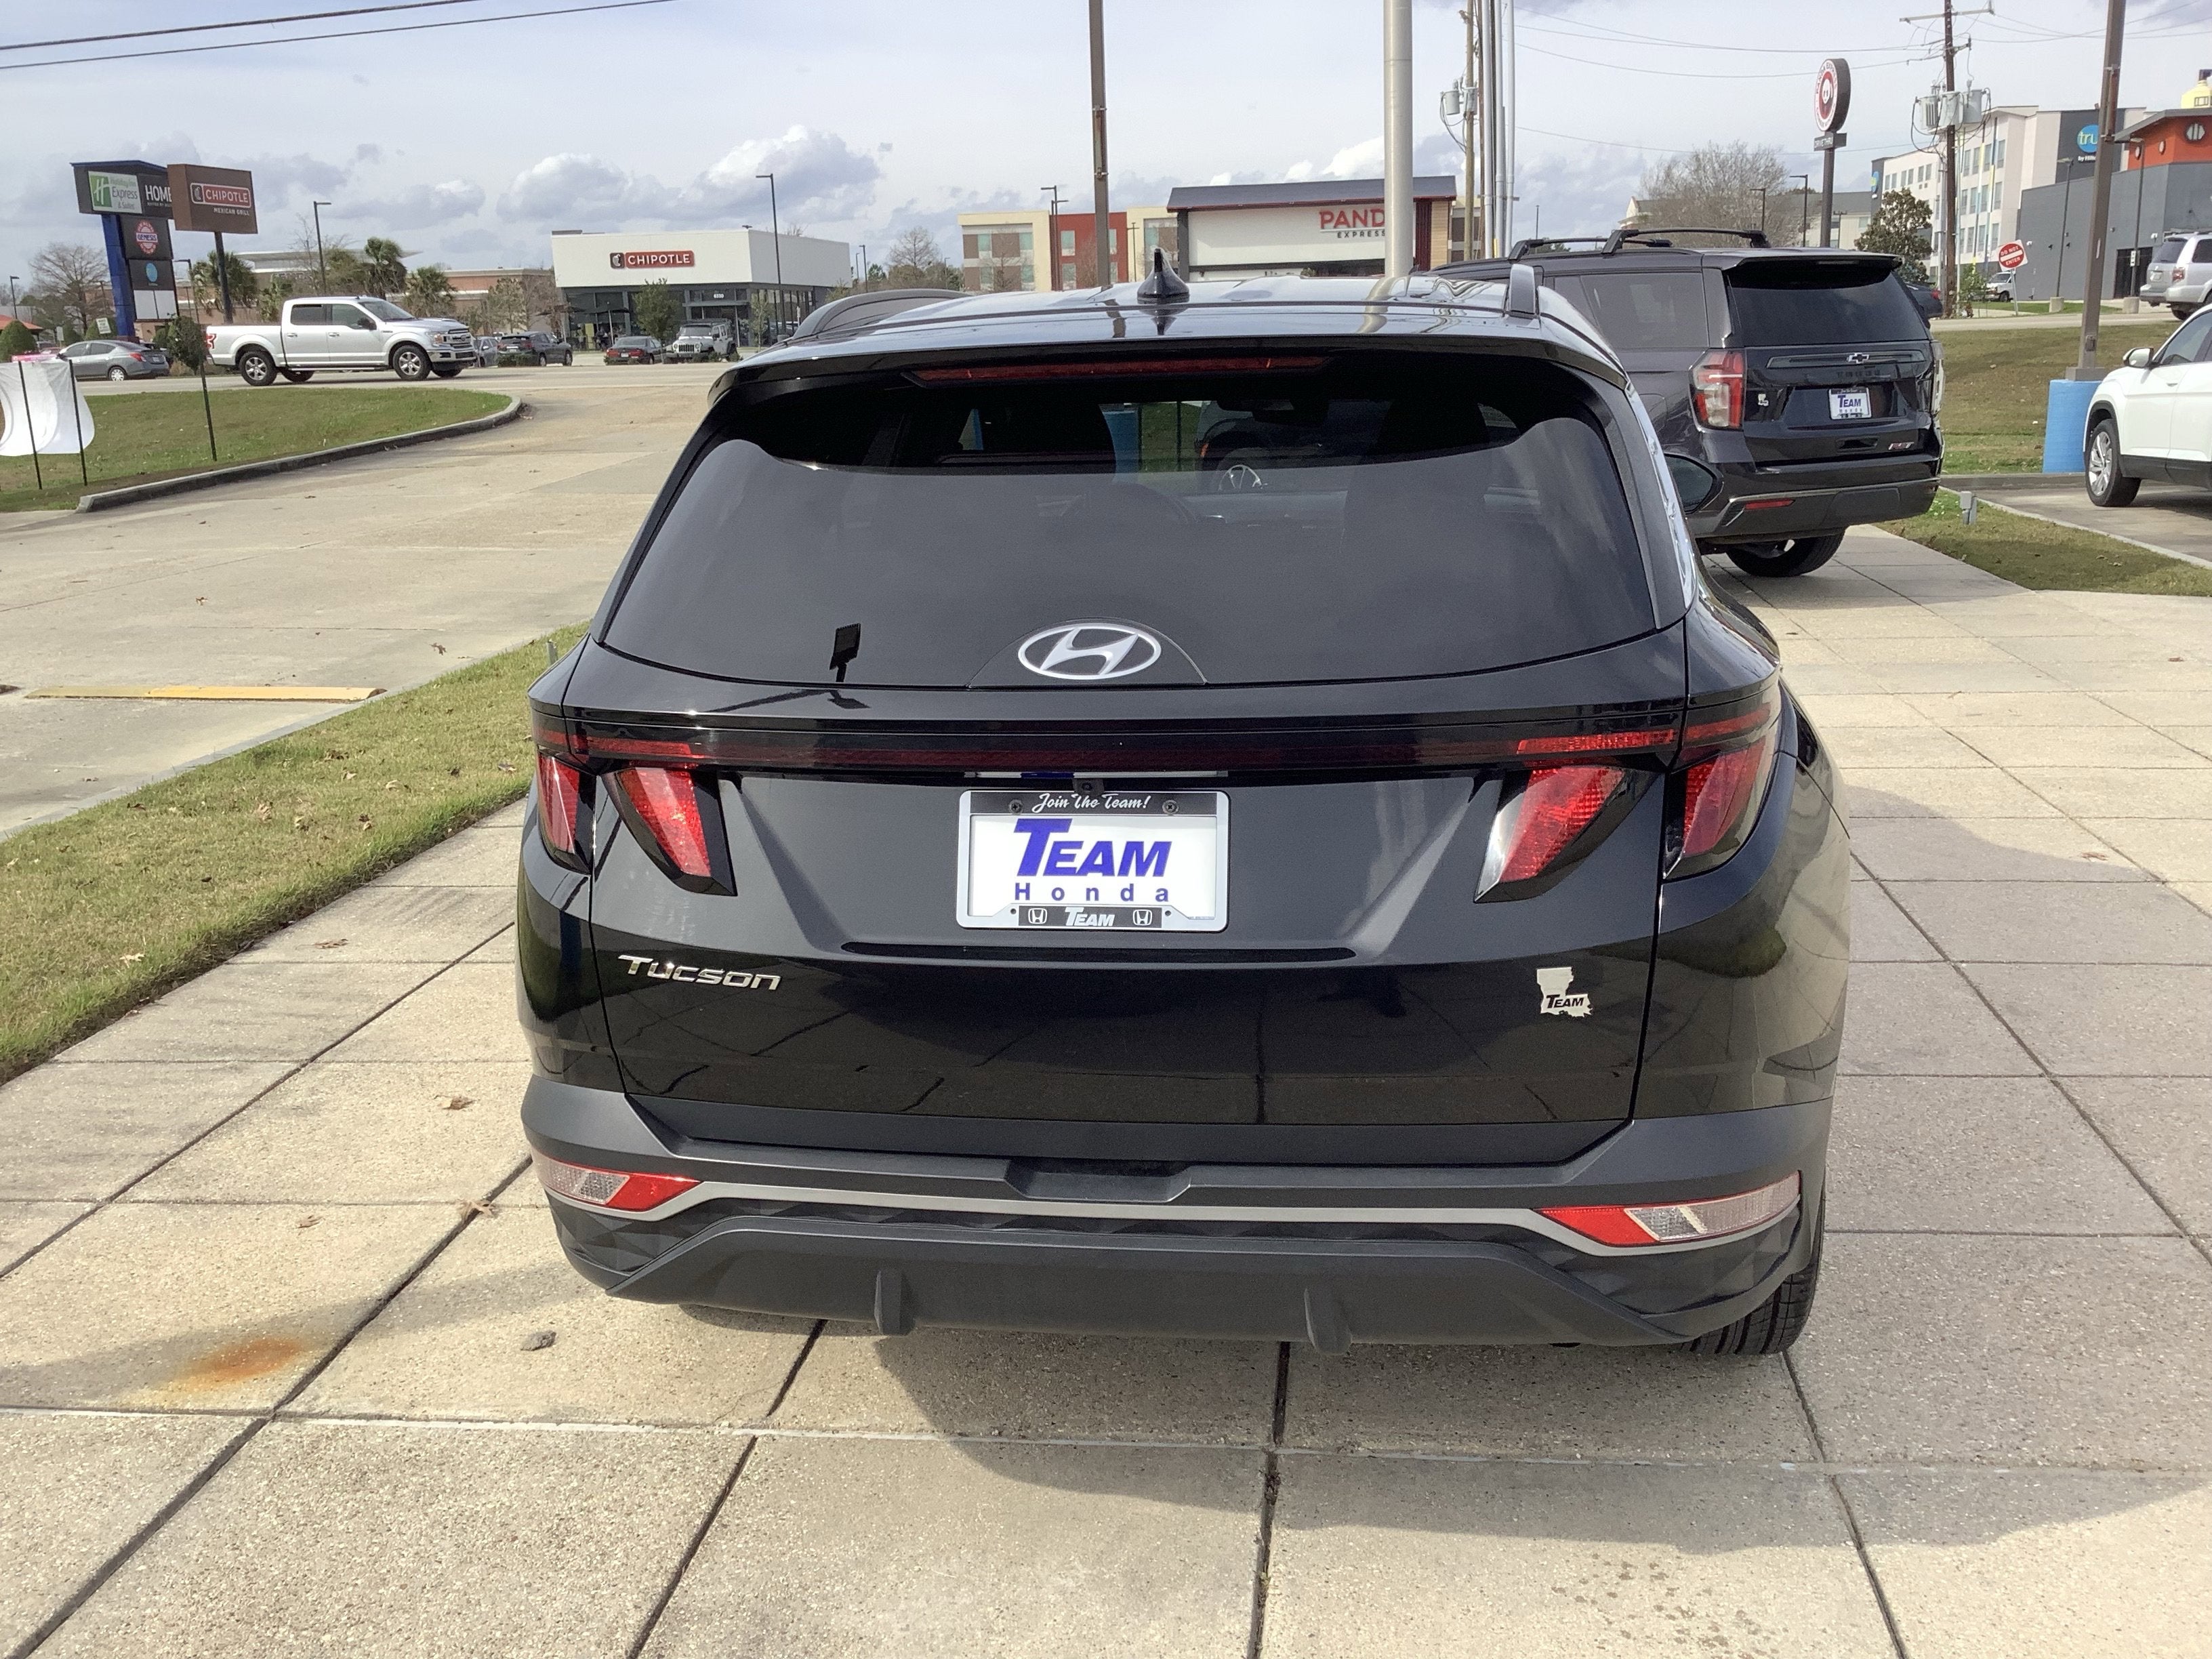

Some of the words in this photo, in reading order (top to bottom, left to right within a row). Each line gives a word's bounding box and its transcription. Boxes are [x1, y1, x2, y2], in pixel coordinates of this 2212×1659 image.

[112, 186, 138, 201] Express
[205, 189, 249, 203] CHIPOTLE
[1319, 209, 1385, 229] PAND
[1337, 229, 1385, 238] EXPRESS
[628, 254, 691, 264] CHIPOTLE
[2006, 257, 2021, 266] ENTER
[1838, 395, 1861, 407] TEAM
[1031, 793, 1069, 813] Join
[1101, 794, 1151, 809] Team!
[1013, 818, 1172, 877] TEAM
[1015, 882, 1169, 902] Honda
[1065, 907, 1115, 926] TEAM
[1546, 994, 1584, 1008] TEAM
